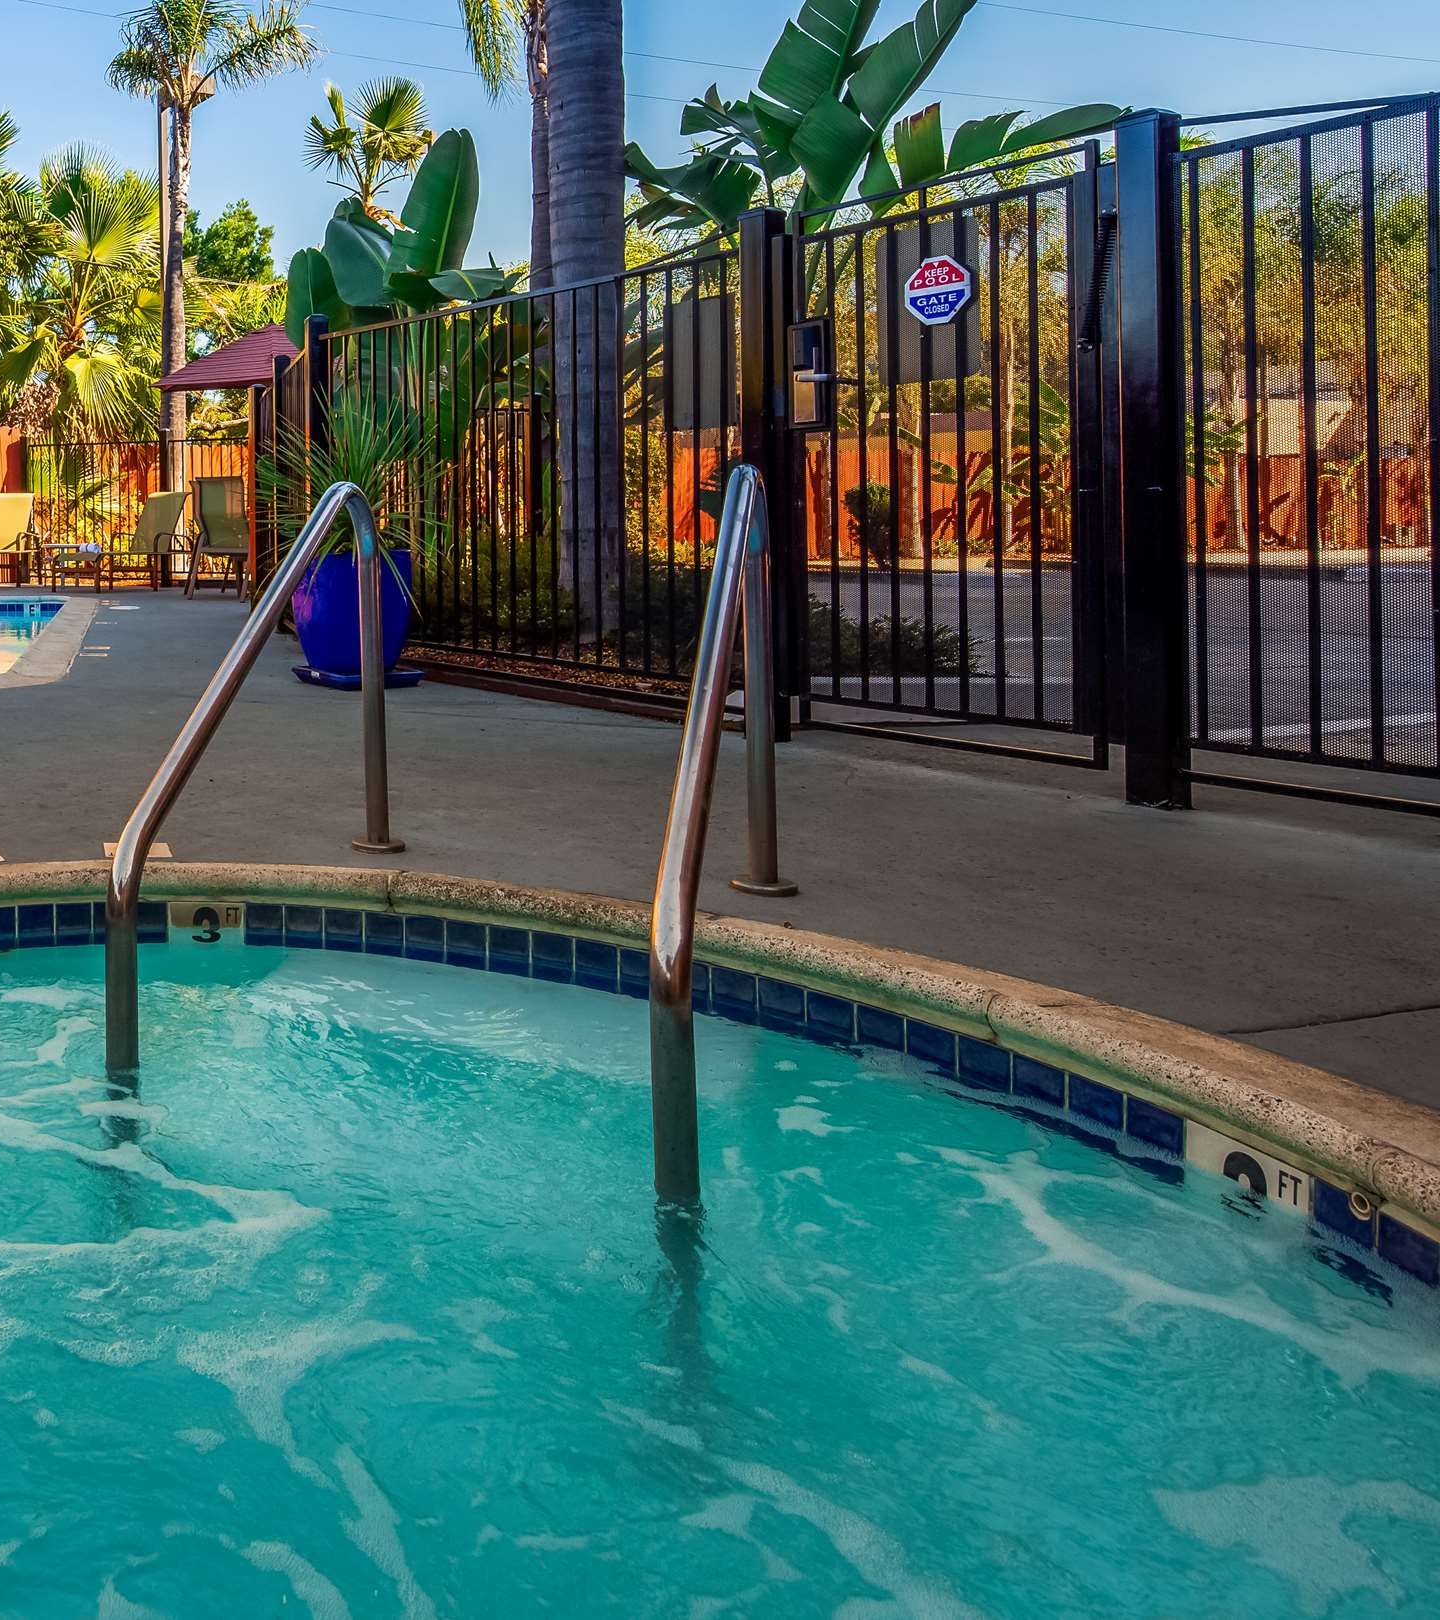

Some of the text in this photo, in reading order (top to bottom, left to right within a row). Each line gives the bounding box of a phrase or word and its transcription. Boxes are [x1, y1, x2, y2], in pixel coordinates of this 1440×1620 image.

[924, 266, 949, 278] KEEP
[914, 273, 960, 288] POOL
[917, 293, 958, 306] GATE
[924, 303, 950, 315] CLOSED
[226, 907, 240, 924] FT
[1278, 1169, 1302, 1206] FT
